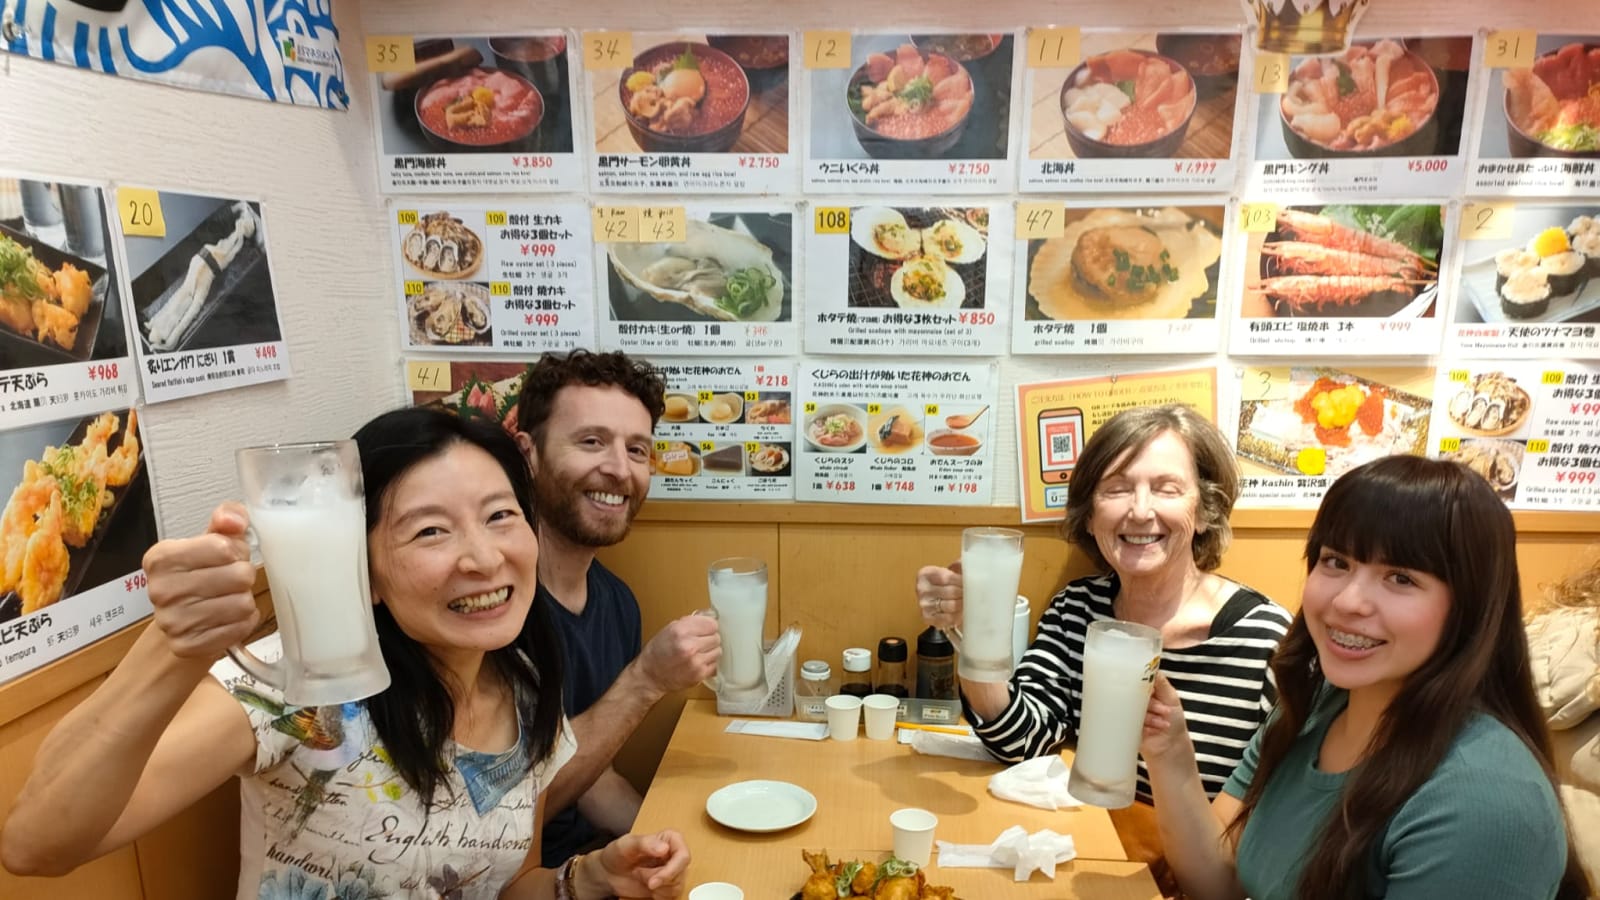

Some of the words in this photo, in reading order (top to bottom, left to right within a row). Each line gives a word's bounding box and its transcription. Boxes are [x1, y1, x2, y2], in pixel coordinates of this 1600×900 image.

[376, 44, 400, 63] 35
[594, 37, 621, 59] 34
[815, 39, 837, 62] 12
[1039, 37, 1064, 60] 11
[1498, 38, 1520, 59] 31
[1260, 64, 1281, 83] 13
[394, 156, 446, 169] 黒門海鮮丼
[598, 156, 691, 168] 黒門サーモン卵黄丼
[819, 162, 880, 174] ウニいくら丼
[1041, 162, 1075, 174] 北海丼
[1263, 162, 1329, 175] 黒門キング丼
[130, 201, 153, 226] 20
[400, 213, 416, 223] 109
[488, 213, 504, 223] 109
[509, 214, 530, 225] 殻付
[534, 214, 563, 225] 生カキ
[1475, 207, 1494, 231] 2
[817, 211, 846, 229] 108
[1026, 209, 1053, 231] 47
[500, 229, 573, 240] お得な3個セット
[605, 220, 628, 239] 42
[652, 221, 675, 240] 43
[520, 244, 556, 257] ¥999
[406, 284, 422, 293] 110
[492, 285, 509, 294] 110
[513, 285, 532, 296] 殻付
[537, 285, 566, 296] 焼カキ
[504, 300, 576, 310] お得な3個セット
[524, 314, 559, 327] ¥999
[882, 312, 957, 325] お得な3枚セット
[958, 312, 995, 325] ¥850
[704, 324, 721, 336] 1個
[848, 327, 867, 335] Grilled
[1033, 323, 1075, 335] ホタテ焼
[1091, 323, 1108, 334] 1個
[1250, 321, 1293, 332] 有頭エビ
[1297, 321, 1330, 332] 塩焼串
[1337, 321, 1354, 332] 3本
[1380, 321, 1412, 331] ¥999
[1508, 326, 1596, 338] 天使のツナマヨ巻
[255, 345, 277, 360] ¥498
[147, 355, 195, 375] 炙りエンガワ
[196, 351, 218, 368] にぎり
[223, 349, 236, 365] 1貫
[88, 363, 119, 381] ¥968
[417, 367, 440, 386] 41
[811, 369, 972, 382] くじらの出汁が効いた花神のおでん
[1452, 373, 1467, 381] 109
[756, 375, 789, 387] ¥218
[1259, 371, 1271, 397] 3
[1545, 373, 1562, 382] 109
[1565, 374, 1588, 385] 殻付
[805, 404, 815, 412] 58
[869, 404, 879, 412] 59
[927, 406, 937, 414] 60
[656, 442, 666, 450] 55
[702, 442, 712, 450] 56
[1442, 441, 1458, 449] 110
[1529, 442, 1546, 451] 110
[1551, 443, 1574, 454] 殻付
[814, 457, 854, 465] くじらのスジ
[874, 457, 914, 465] くじらのコロ
[1262, 478, 1294, 487] Kashin
[1555, 472, 1597, 484] ¥999
[826, 481, 856, 491] ¥638
[885, 481, 915, 491] ¥748
[948, 482, 977, 493] ¥198
[125, 576, 149, 593] ¥96
[5, 645, 37, 665] tempura
